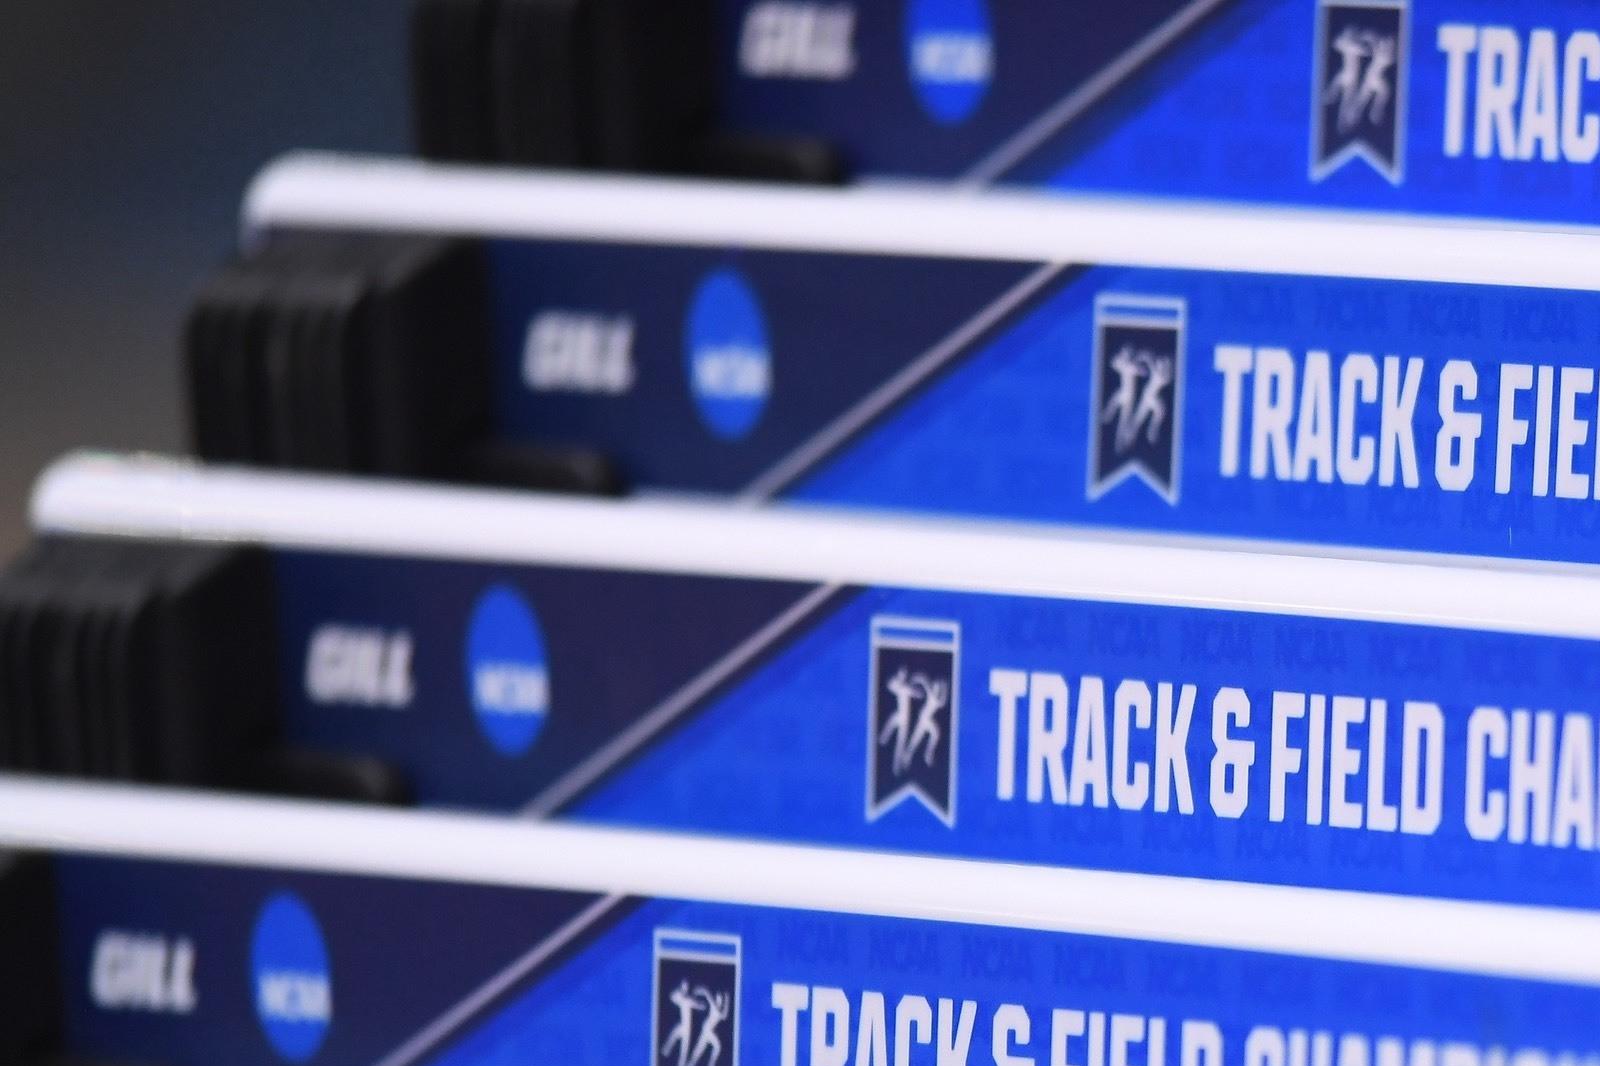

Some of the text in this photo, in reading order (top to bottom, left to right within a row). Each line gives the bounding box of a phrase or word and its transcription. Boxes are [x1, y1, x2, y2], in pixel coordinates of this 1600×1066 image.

[1214, 345, 1424, 488] TRACK
[1434, 359, 1482, 492] &
[989, 668, 1197, 815] TRACK
[1209, 686, 1256, 819] &
[1269, 691, 1445, 835] FIELD
